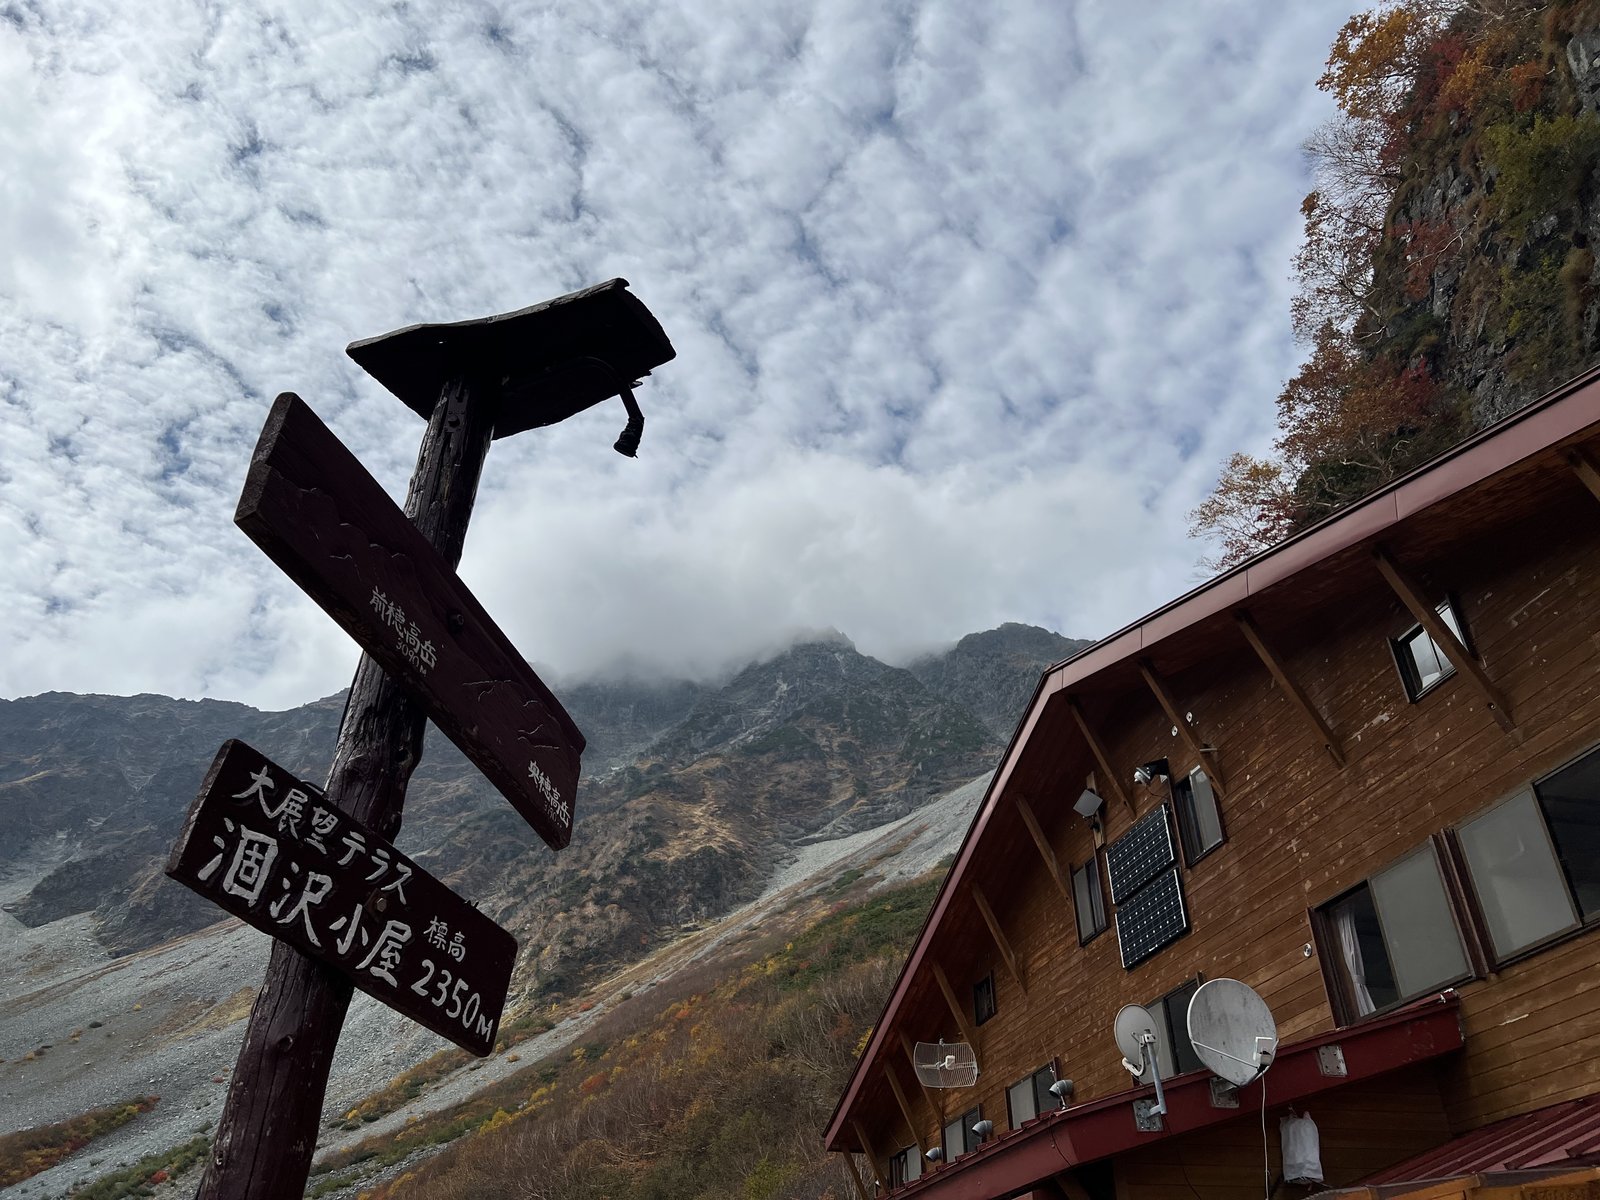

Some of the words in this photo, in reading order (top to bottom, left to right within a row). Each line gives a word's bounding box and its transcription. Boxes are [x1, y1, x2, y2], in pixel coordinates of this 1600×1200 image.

[197, 817, 412, 988] 涸沢小屋
[231, 765, 413, 905] 大展望テラス
[422, 915, 466, 963] 標高
